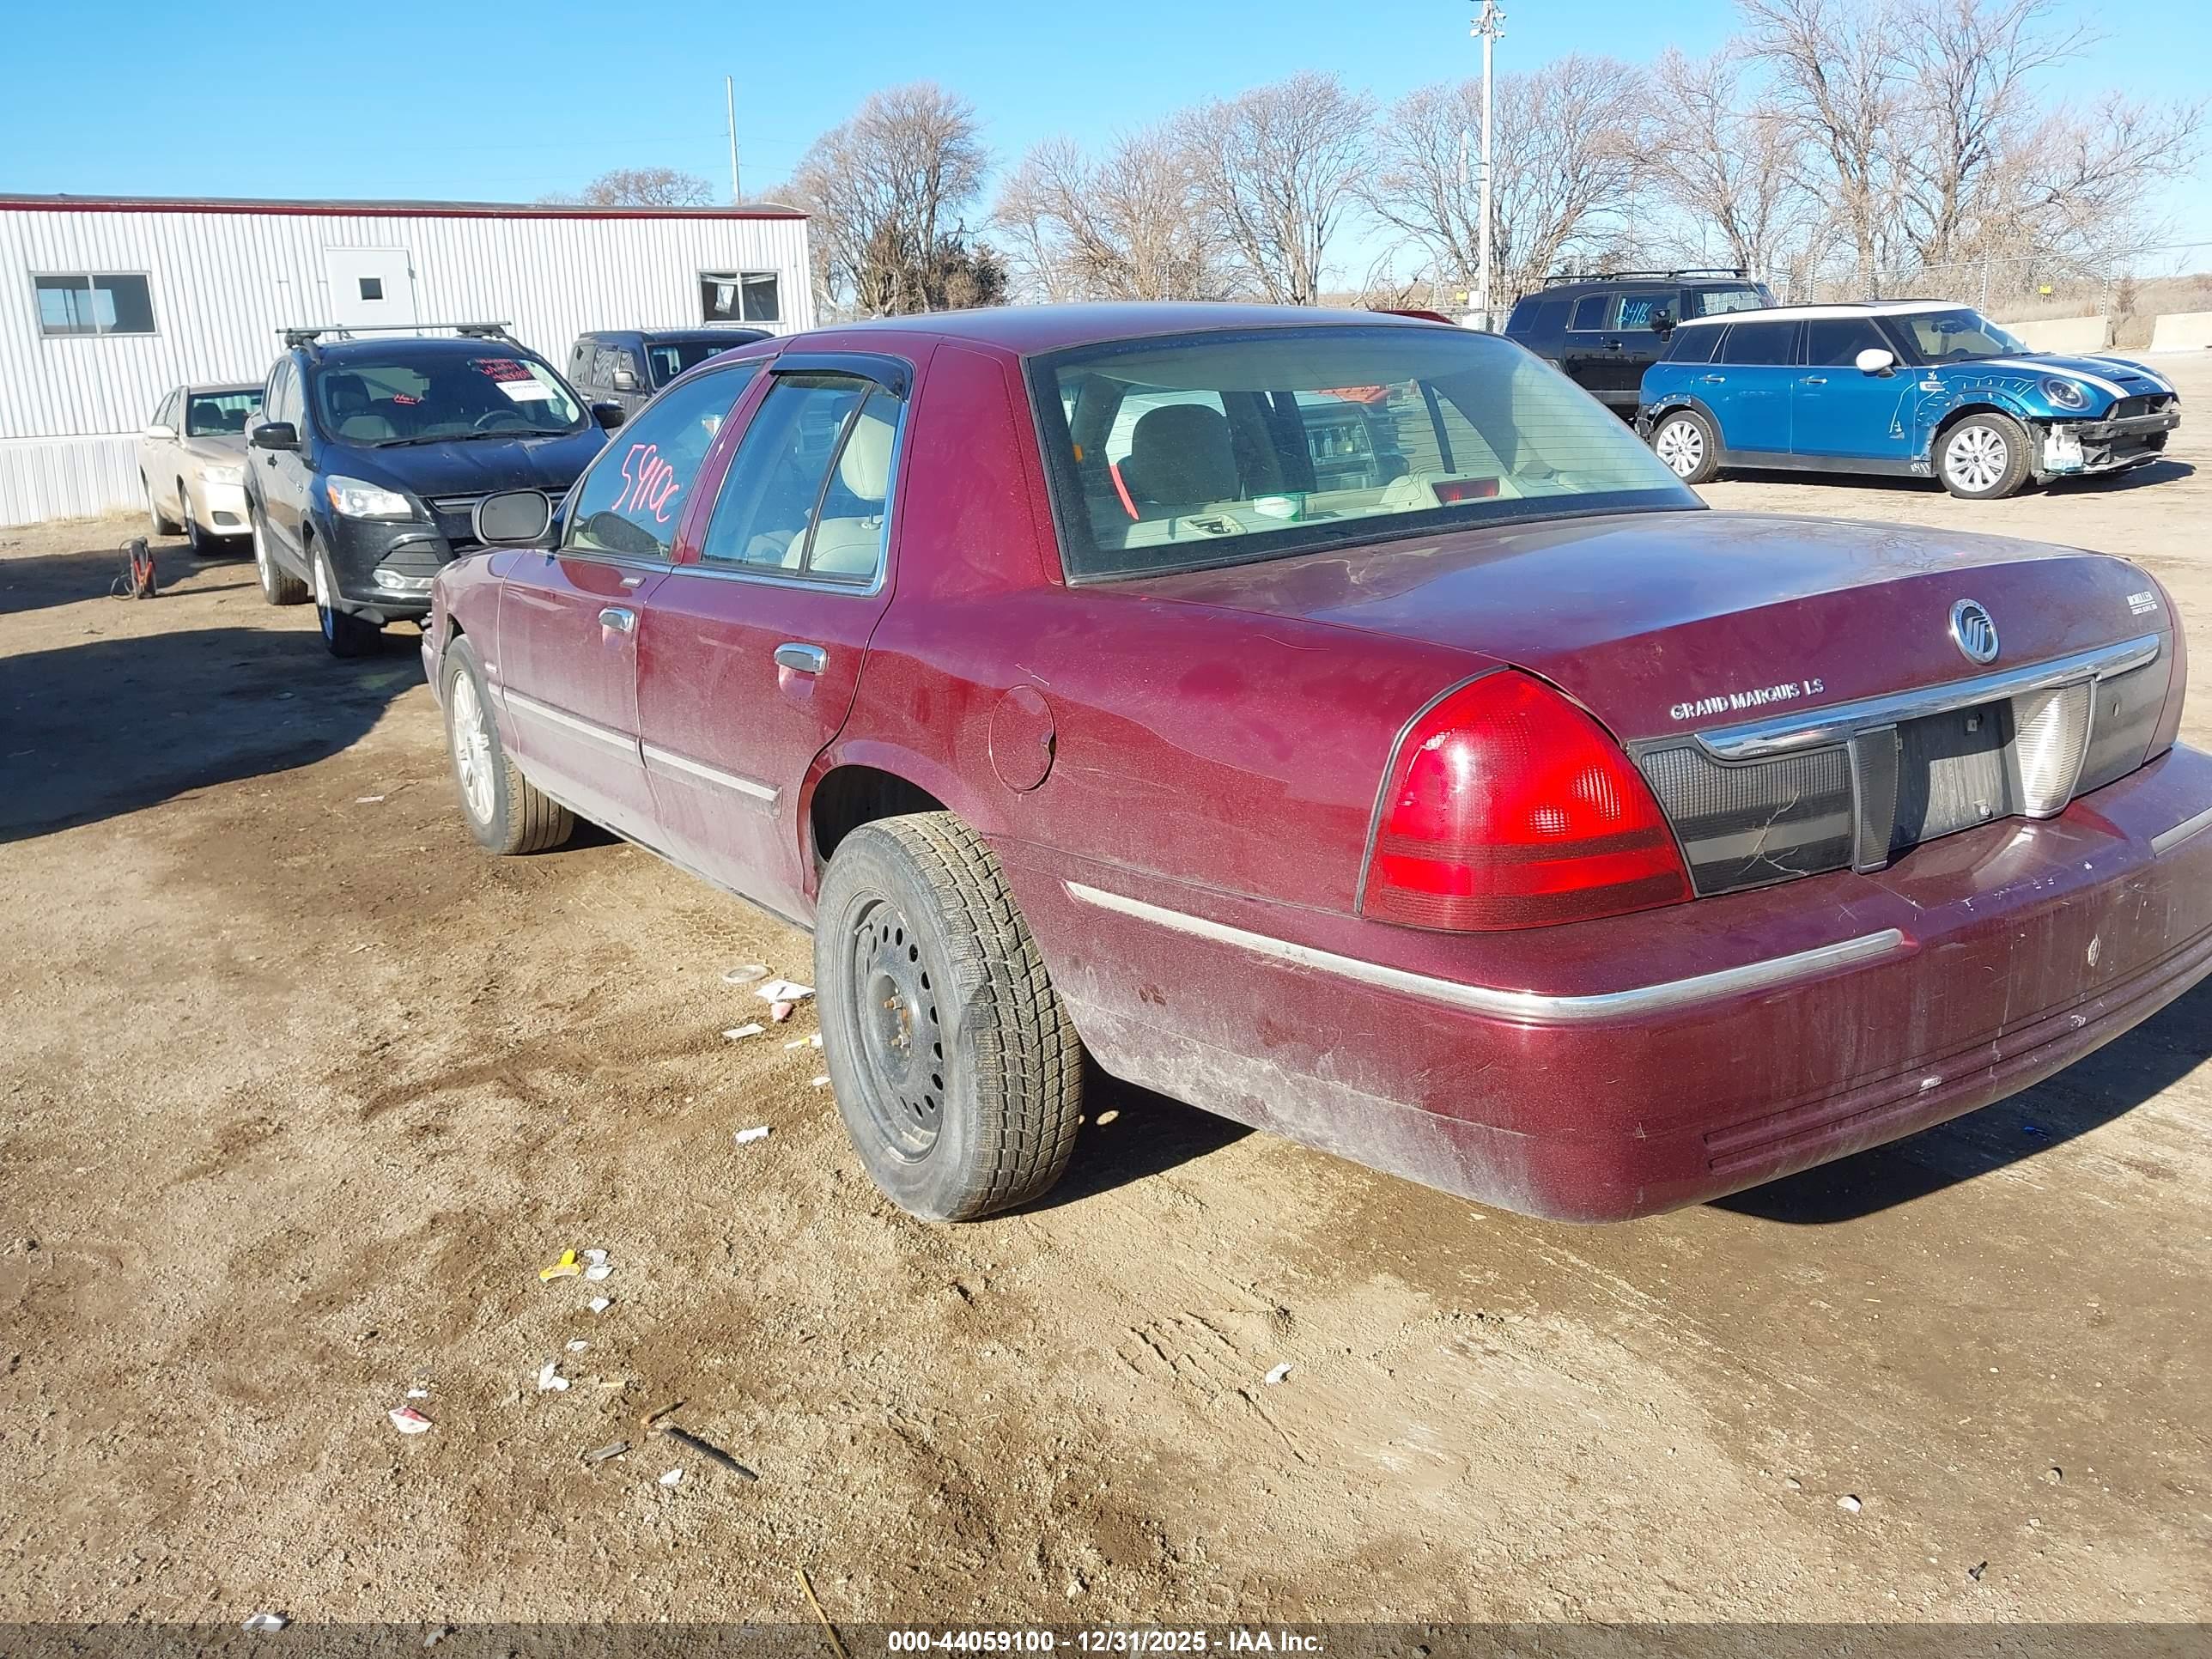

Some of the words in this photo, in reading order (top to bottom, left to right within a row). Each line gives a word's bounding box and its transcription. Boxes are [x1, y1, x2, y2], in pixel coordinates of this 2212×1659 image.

[1670, 696, 1729, 720] GRAND
[1729, 682, 1801, 710] MARQUIS
[1803, 678, 1825, 696] LS
